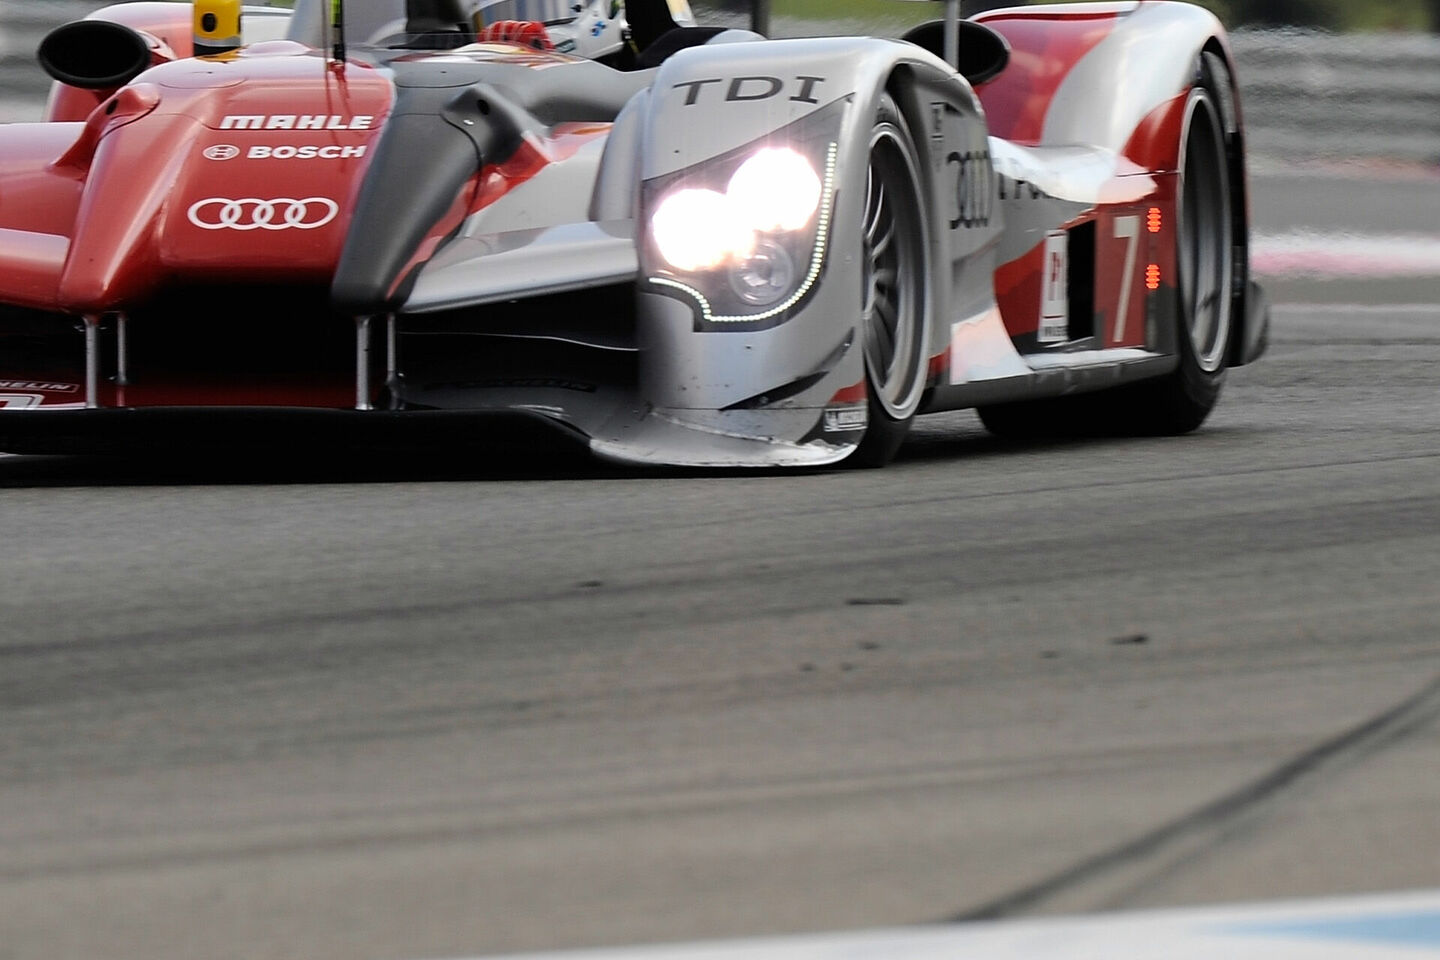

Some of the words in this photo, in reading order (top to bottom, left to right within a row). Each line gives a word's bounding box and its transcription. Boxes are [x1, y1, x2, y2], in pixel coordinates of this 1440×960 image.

[671, 75, 826, 105] TDI
[218, 115, 374, 130] MAHLE
[247, 145, 368, 159] BOSCH
[1112, 215, 1140, 343] 7
